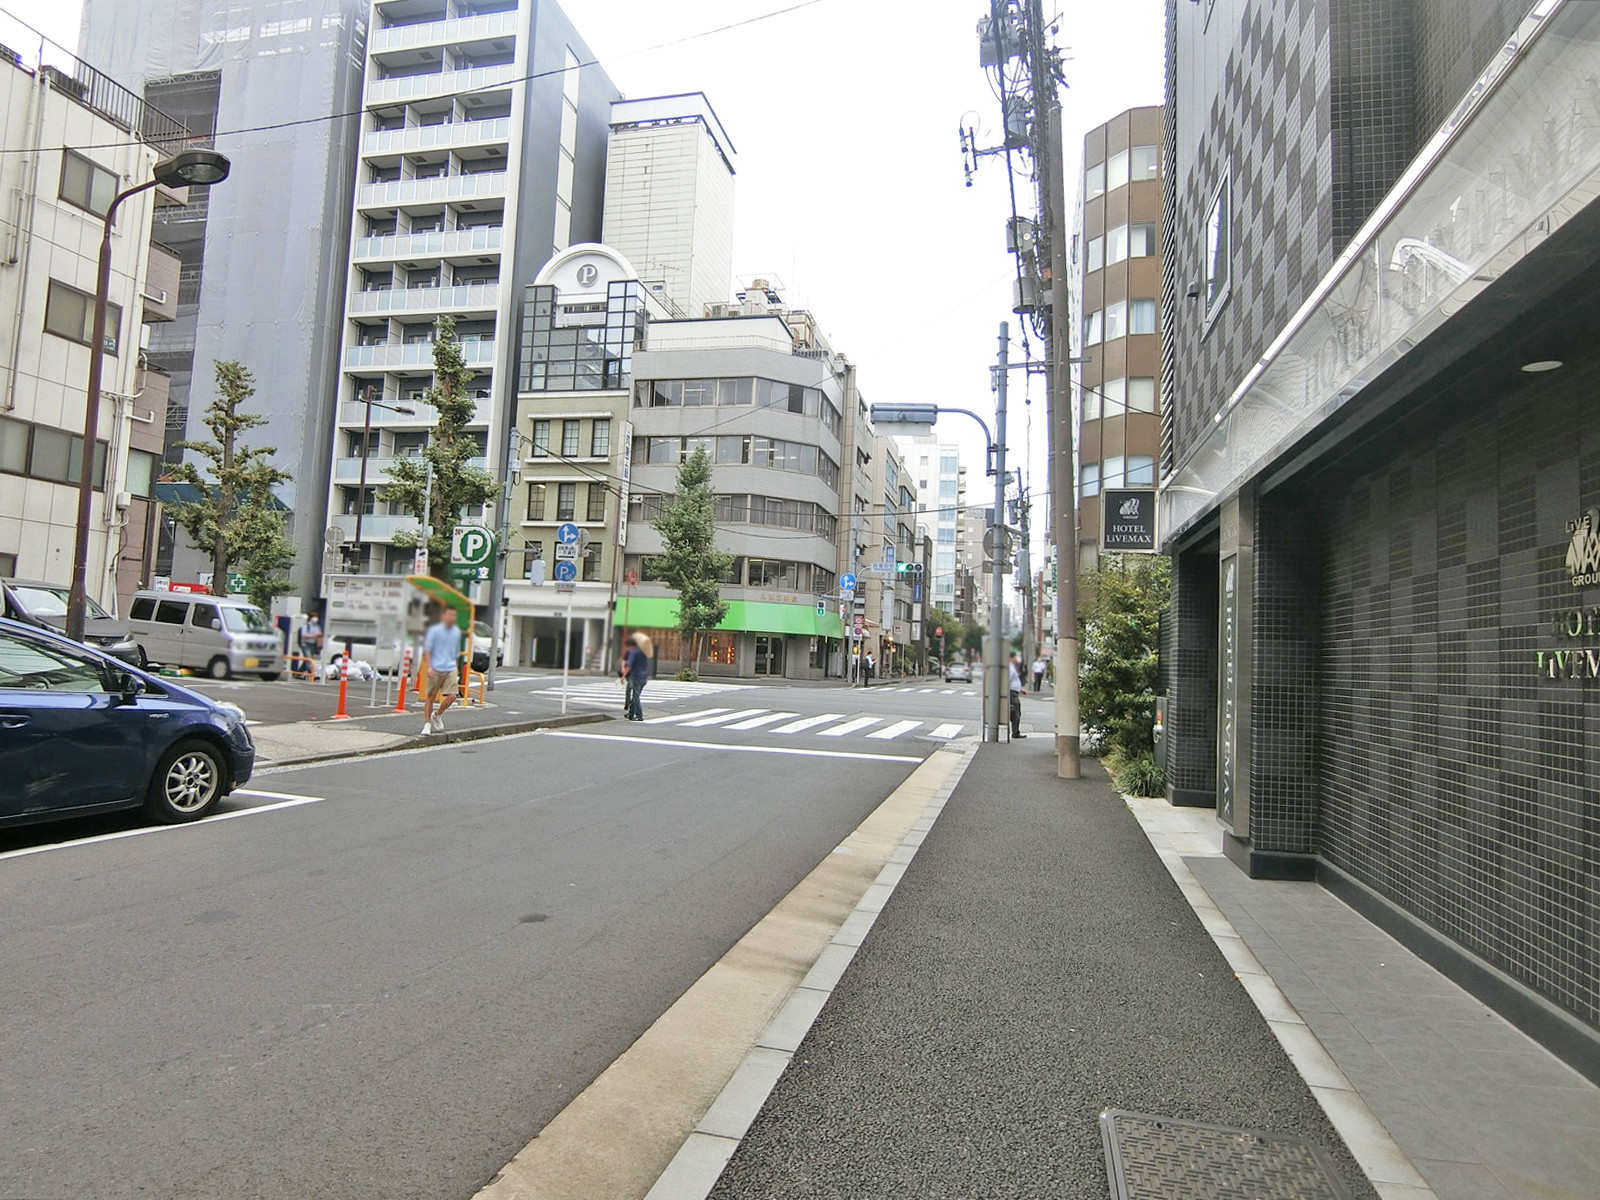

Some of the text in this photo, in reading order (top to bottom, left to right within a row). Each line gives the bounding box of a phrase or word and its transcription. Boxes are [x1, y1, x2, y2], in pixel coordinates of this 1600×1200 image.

[581, 266, 596, 283] P
[1112, 525, 1146, 533] HOTEL
[466, 534, 484, 558] P
[1572, 573, 1600, 586] GROU
